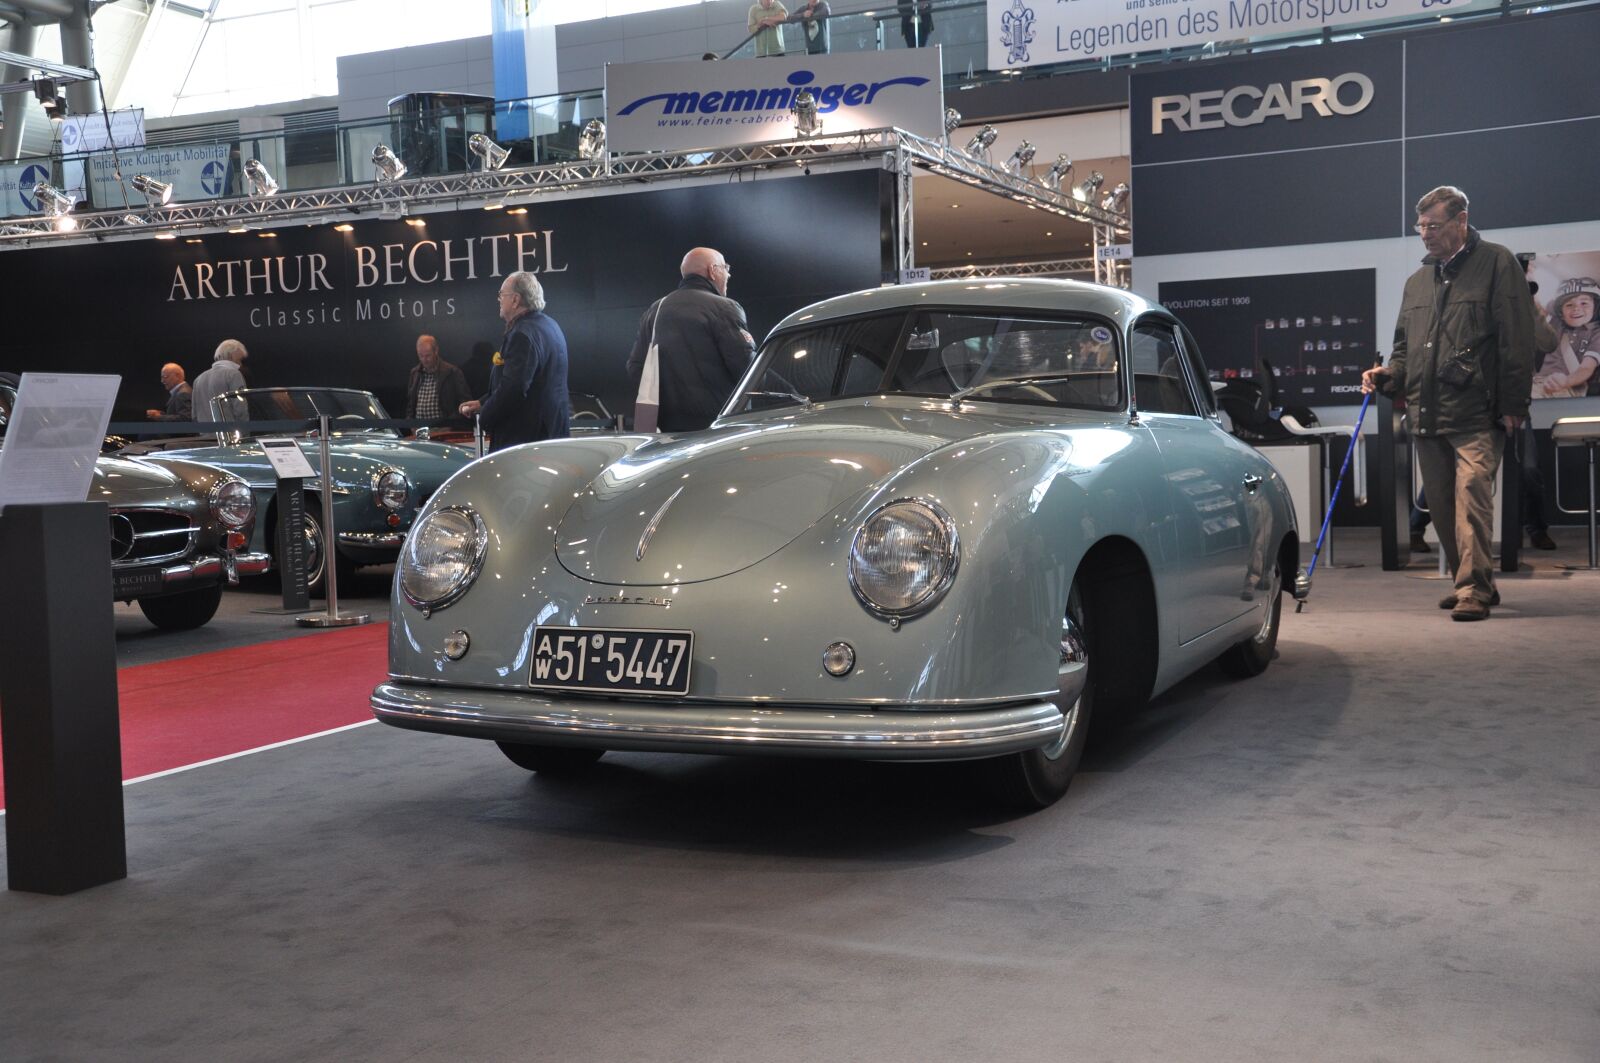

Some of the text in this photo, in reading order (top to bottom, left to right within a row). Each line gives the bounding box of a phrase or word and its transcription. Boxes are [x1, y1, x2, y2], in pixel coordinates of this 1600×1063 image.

[1056, 15, 1168, 55] Legenden
[1178, 7, 1219, 37] des
[1151, 71, 1375, 135] RECARO
[93, 147, 228, 170] Initiaive Kulturgut Mobilität
[167, 229, 569, 301] ARTHUR BECHTEL
[906, 270, 925, 279] 1D12
[249, 298, 456, 328] Classic Motors
[1331, 385, 1363, 393] RECAR
